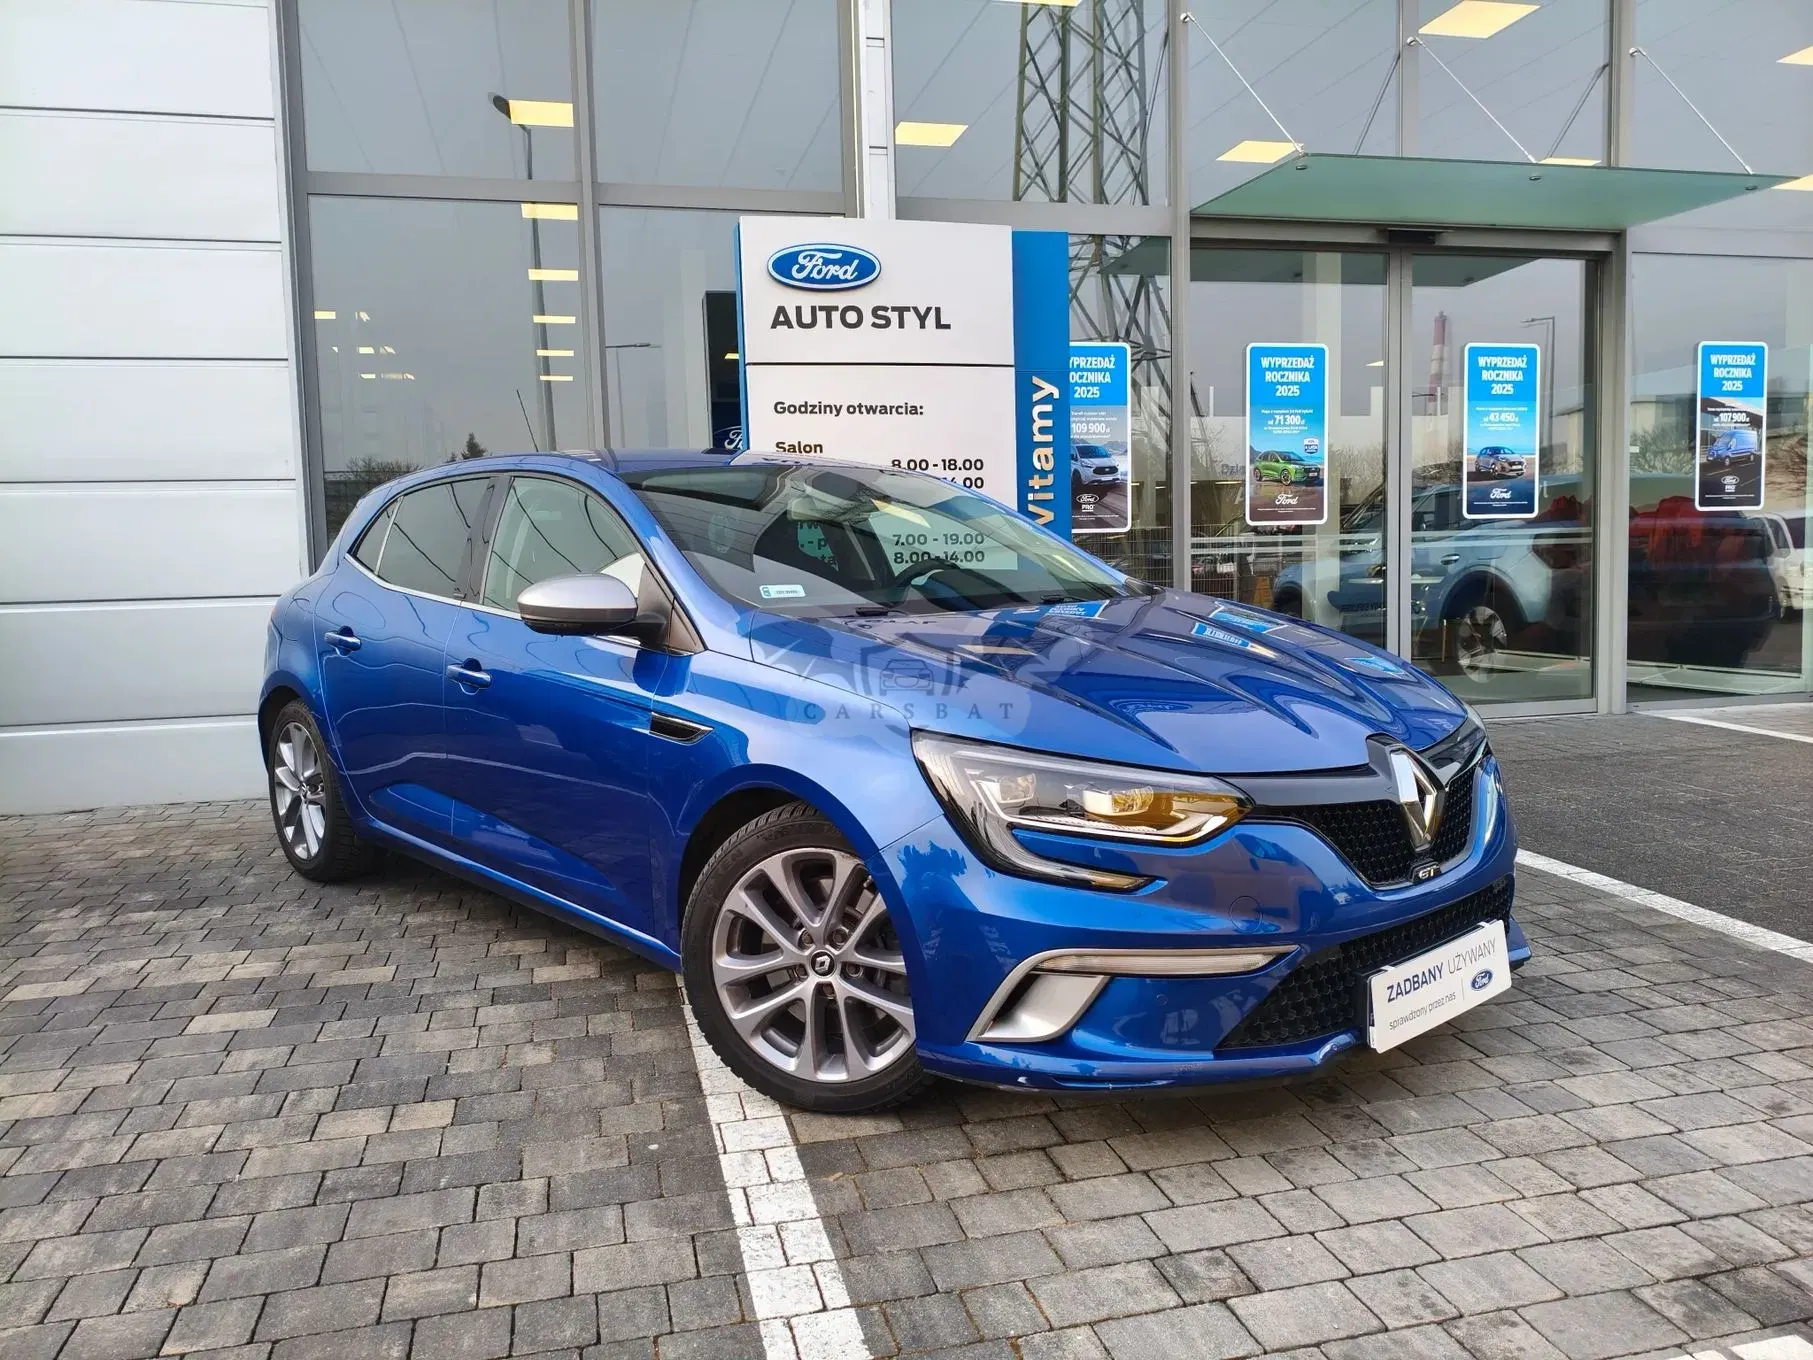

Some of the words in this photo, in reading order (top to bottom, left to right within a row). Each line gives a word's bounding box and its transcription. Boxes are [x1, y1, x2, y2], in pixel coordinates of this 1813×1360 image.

[792, 250, 860, 280] Ford
[770, 305, 864, 329] AUTO
[870, 305, 951, 330] STYL
[1069, 354, 1116, 369] YPRZEDAŻ
[1261, 354, 1315, 368] WYPRZEDAŻ
[1477, 354, 1528, 368] WYPRZEDAŻ
[1710, 352, 1756, 366] WYPRZEDAŻ
[1069, 371, 1112, 384] OCZNIKA
[1265, 371, 1311, 383] ROCZNIKA
[1481, 370, 1524, 382] ROCZNIKA
[1713, 367, 1753, 378] ROCZNIKA
[1073, 386, 1100, 398] 2025
[1275, 385, 1300, 397] 2025
[1491, 383, 1514, 395] 2025
[1721, 381, 1743, 392] 2025
[773, 401, 843, 417] Godziny
[846, 402, 924, 415] otwarcia:
[1088, 422, 1106, 433] 900
[775, 441, 823, 454] Salon
[941, 458, 984, 471] 18.00
[1275, 493, 1298, 505] Ford
[1490, 487, 1512, 499] Ford
[892, 533, 928, 546] 7.00
[943, 533, 984, 545] 19.00
[893, 551, 931, 564] 8.00
[943, 550, 985, 563] 14.00
[1418, 865, 1440, 879] GT
[1387, 962, 1444, 1003] ZADBANY
[1447, 937, 1496, 974] UŻYWANY
[1389, 1005, 1428, 1030] sprawdzony
[1428, 997, 1444, 1012] przez
[1445, 991, 1457, 1003] nas
